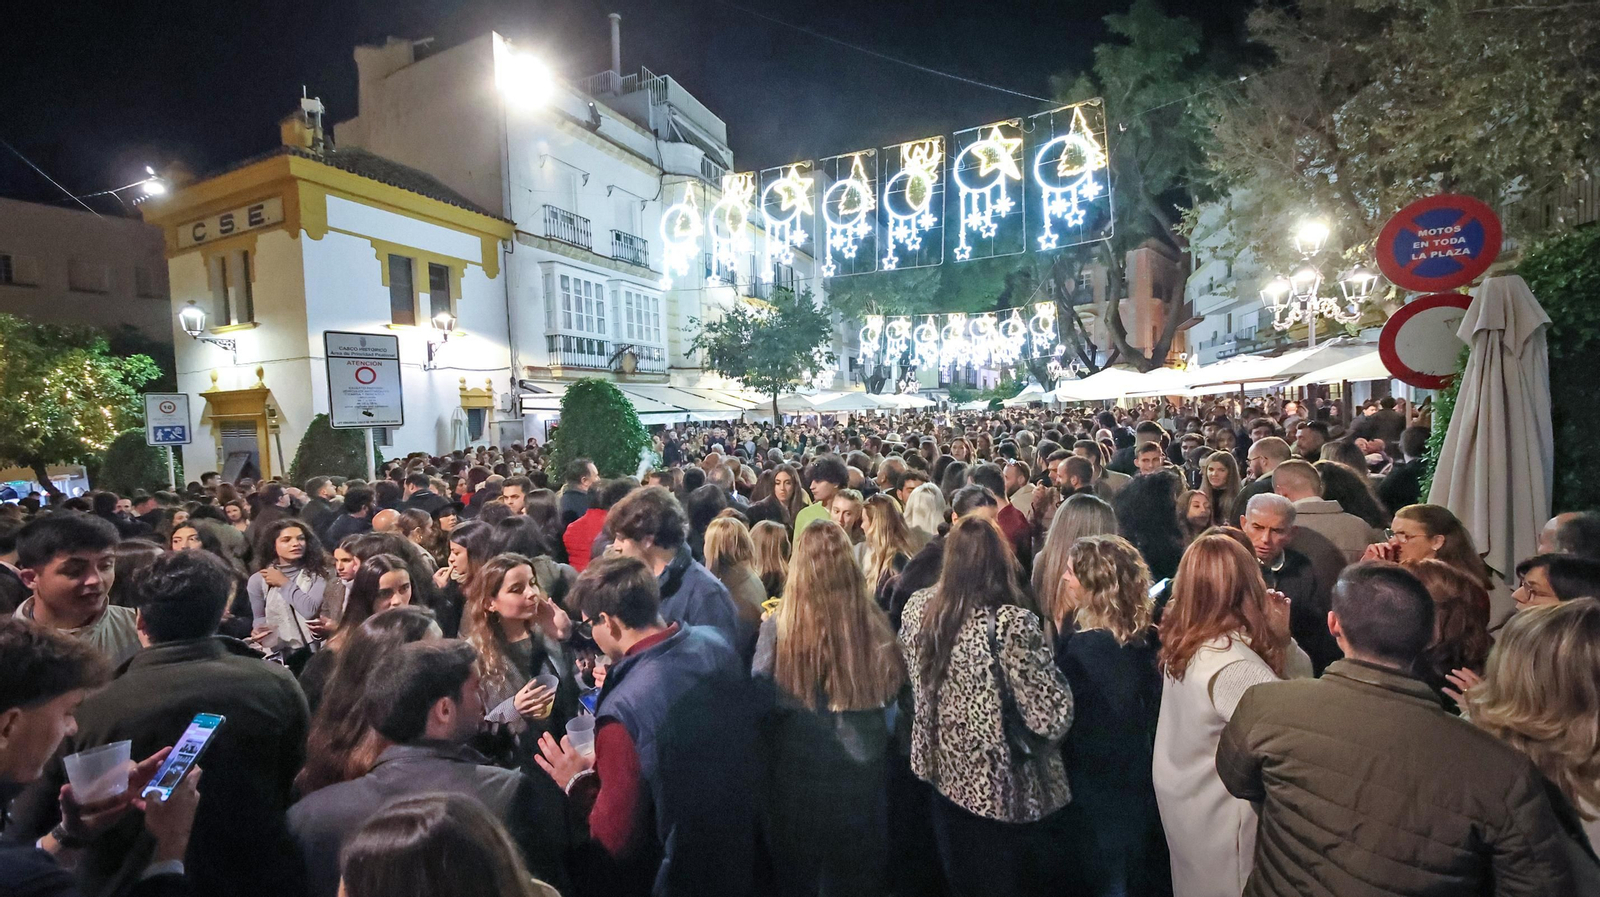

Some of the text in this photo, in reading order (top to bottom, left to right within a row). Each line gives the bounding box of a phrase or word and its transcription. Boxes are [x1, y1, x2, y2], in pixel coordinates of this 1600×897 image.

[1418, 226, 1462, 237] MOTOS
[1412, 236, 1466, 249] EN TODA
[1411, 248, 1471, 261] LA PLAZA
